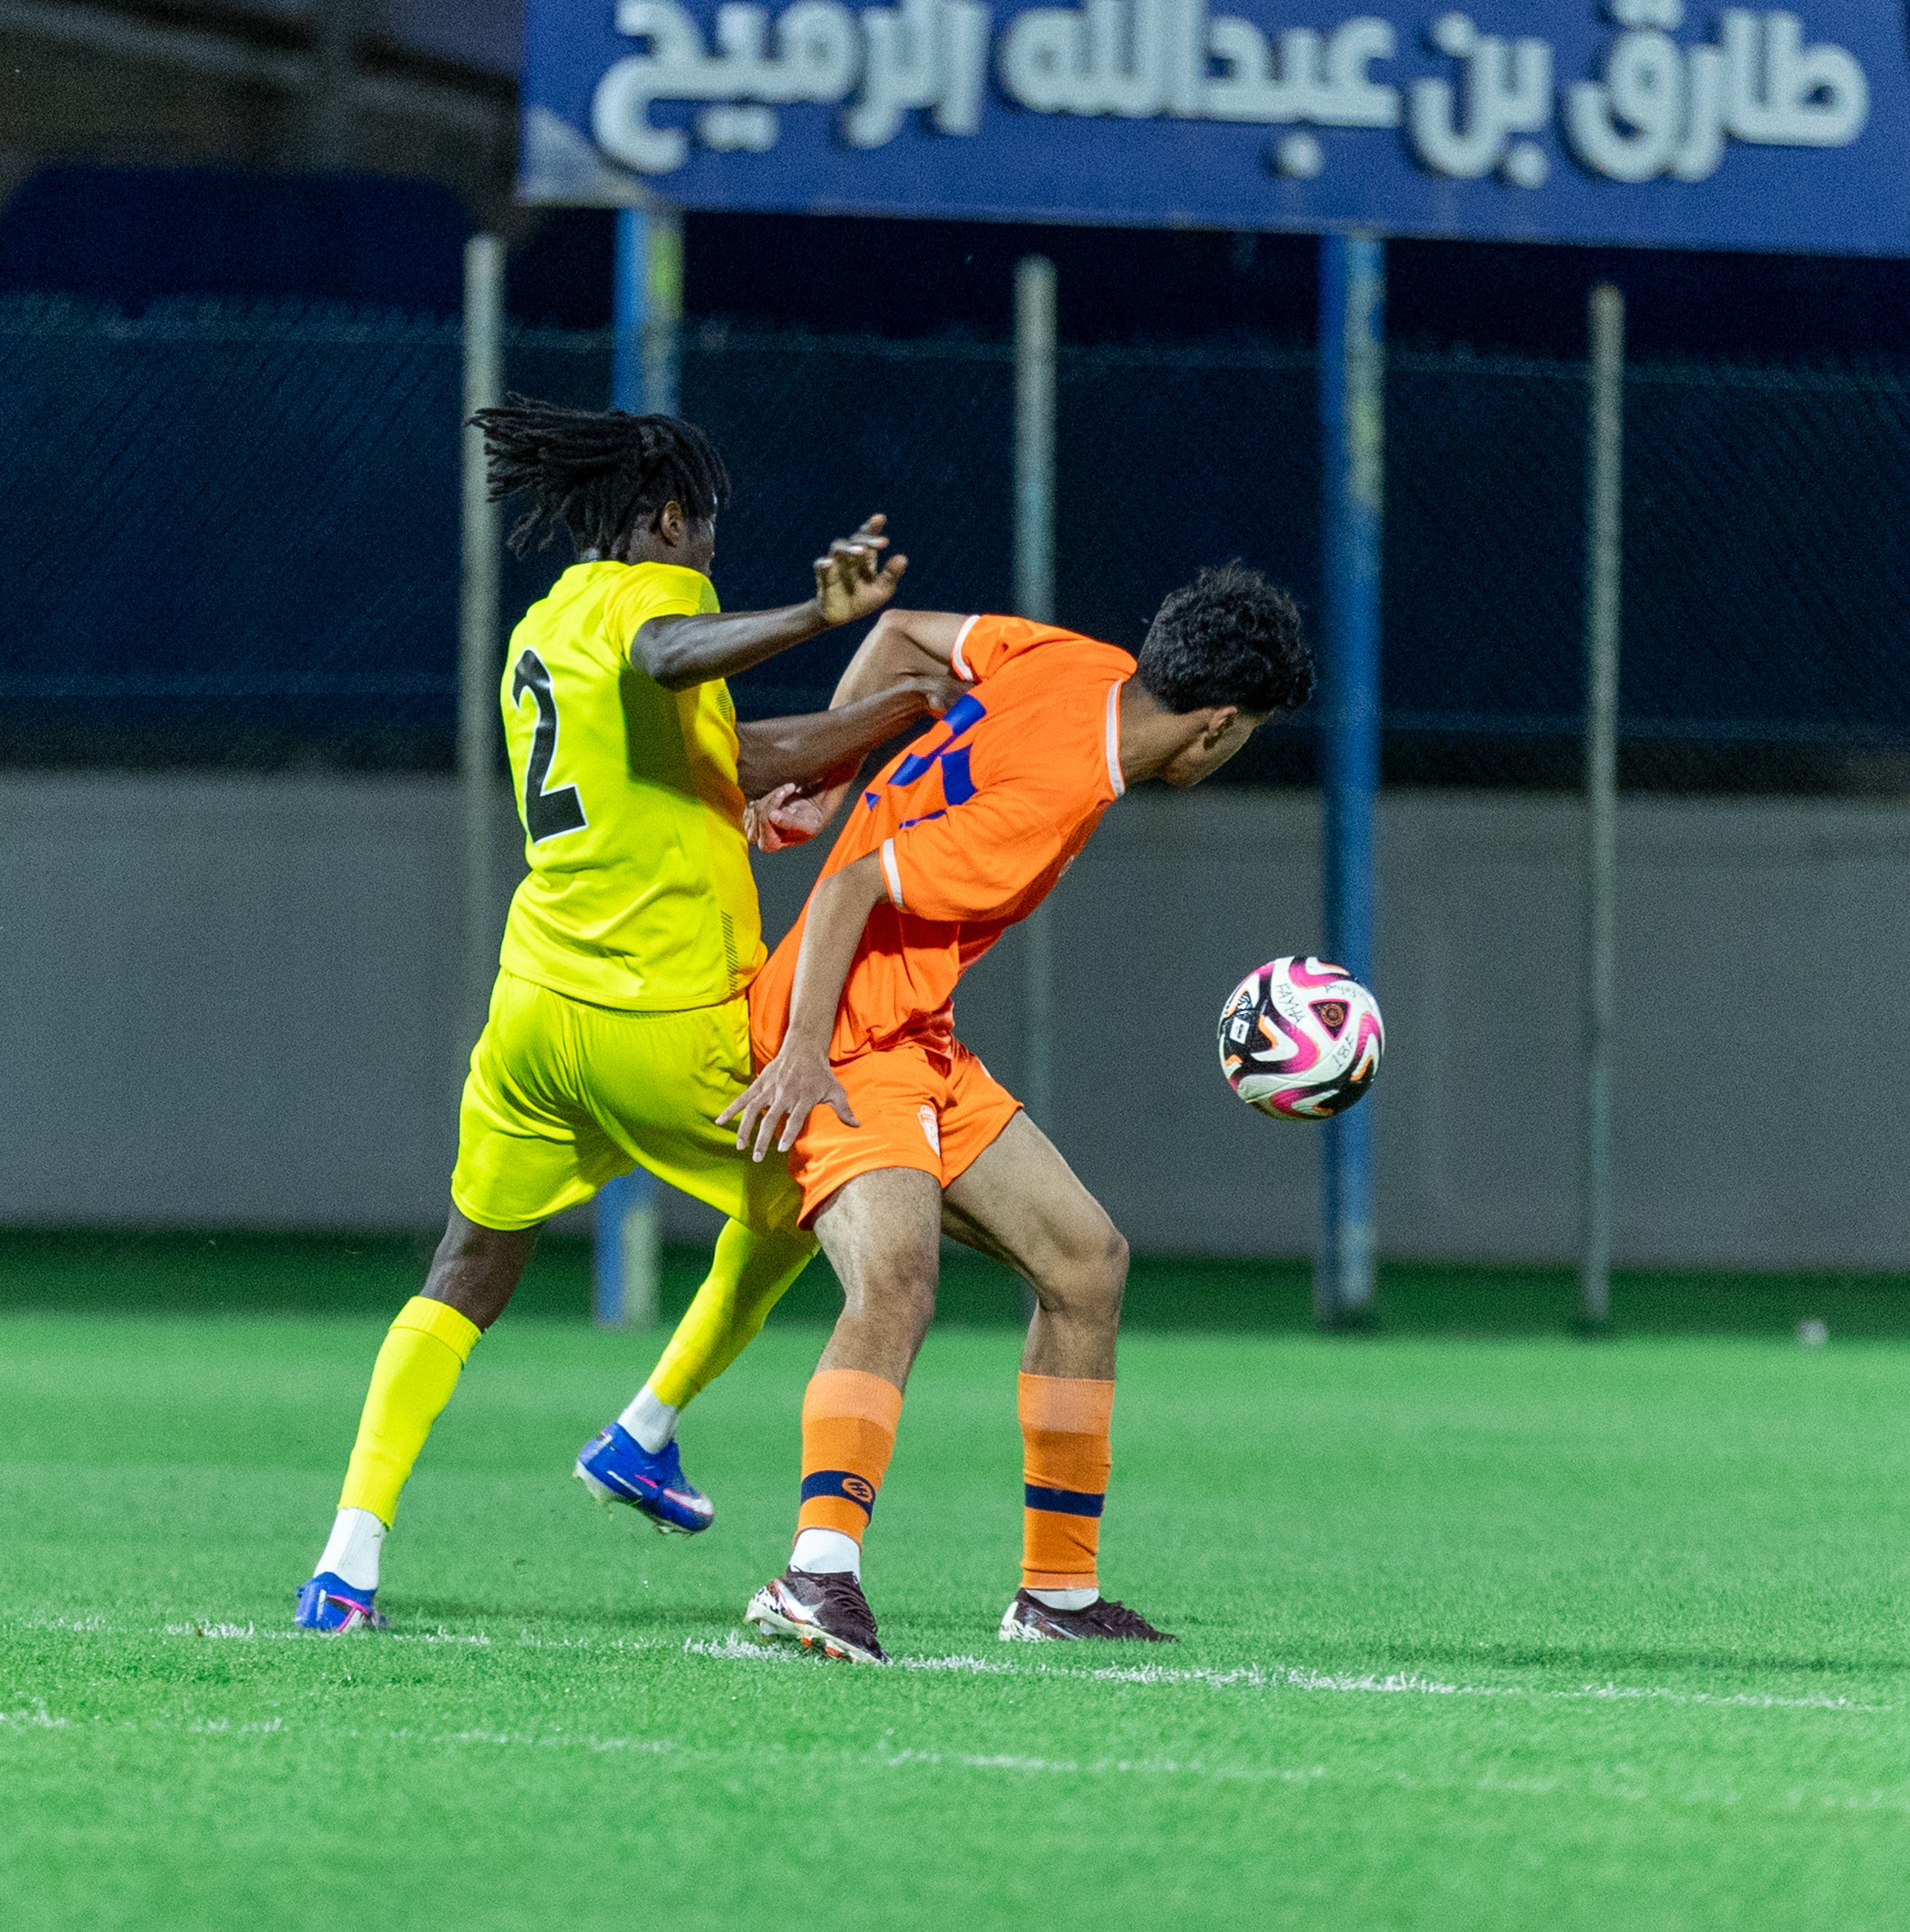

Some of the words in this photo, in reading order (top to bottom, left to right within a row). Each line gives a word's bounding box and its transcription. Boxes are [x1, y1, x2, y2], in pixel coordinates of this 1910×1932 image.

[593, 0, 989, 173] الرميح
[1410, 12, 1548, 188] بن
[1567, 0, 1868, 182] طارق
[512, 647, 589, 845] 2
[1275, 983, 1305, 1024] FAYHA
